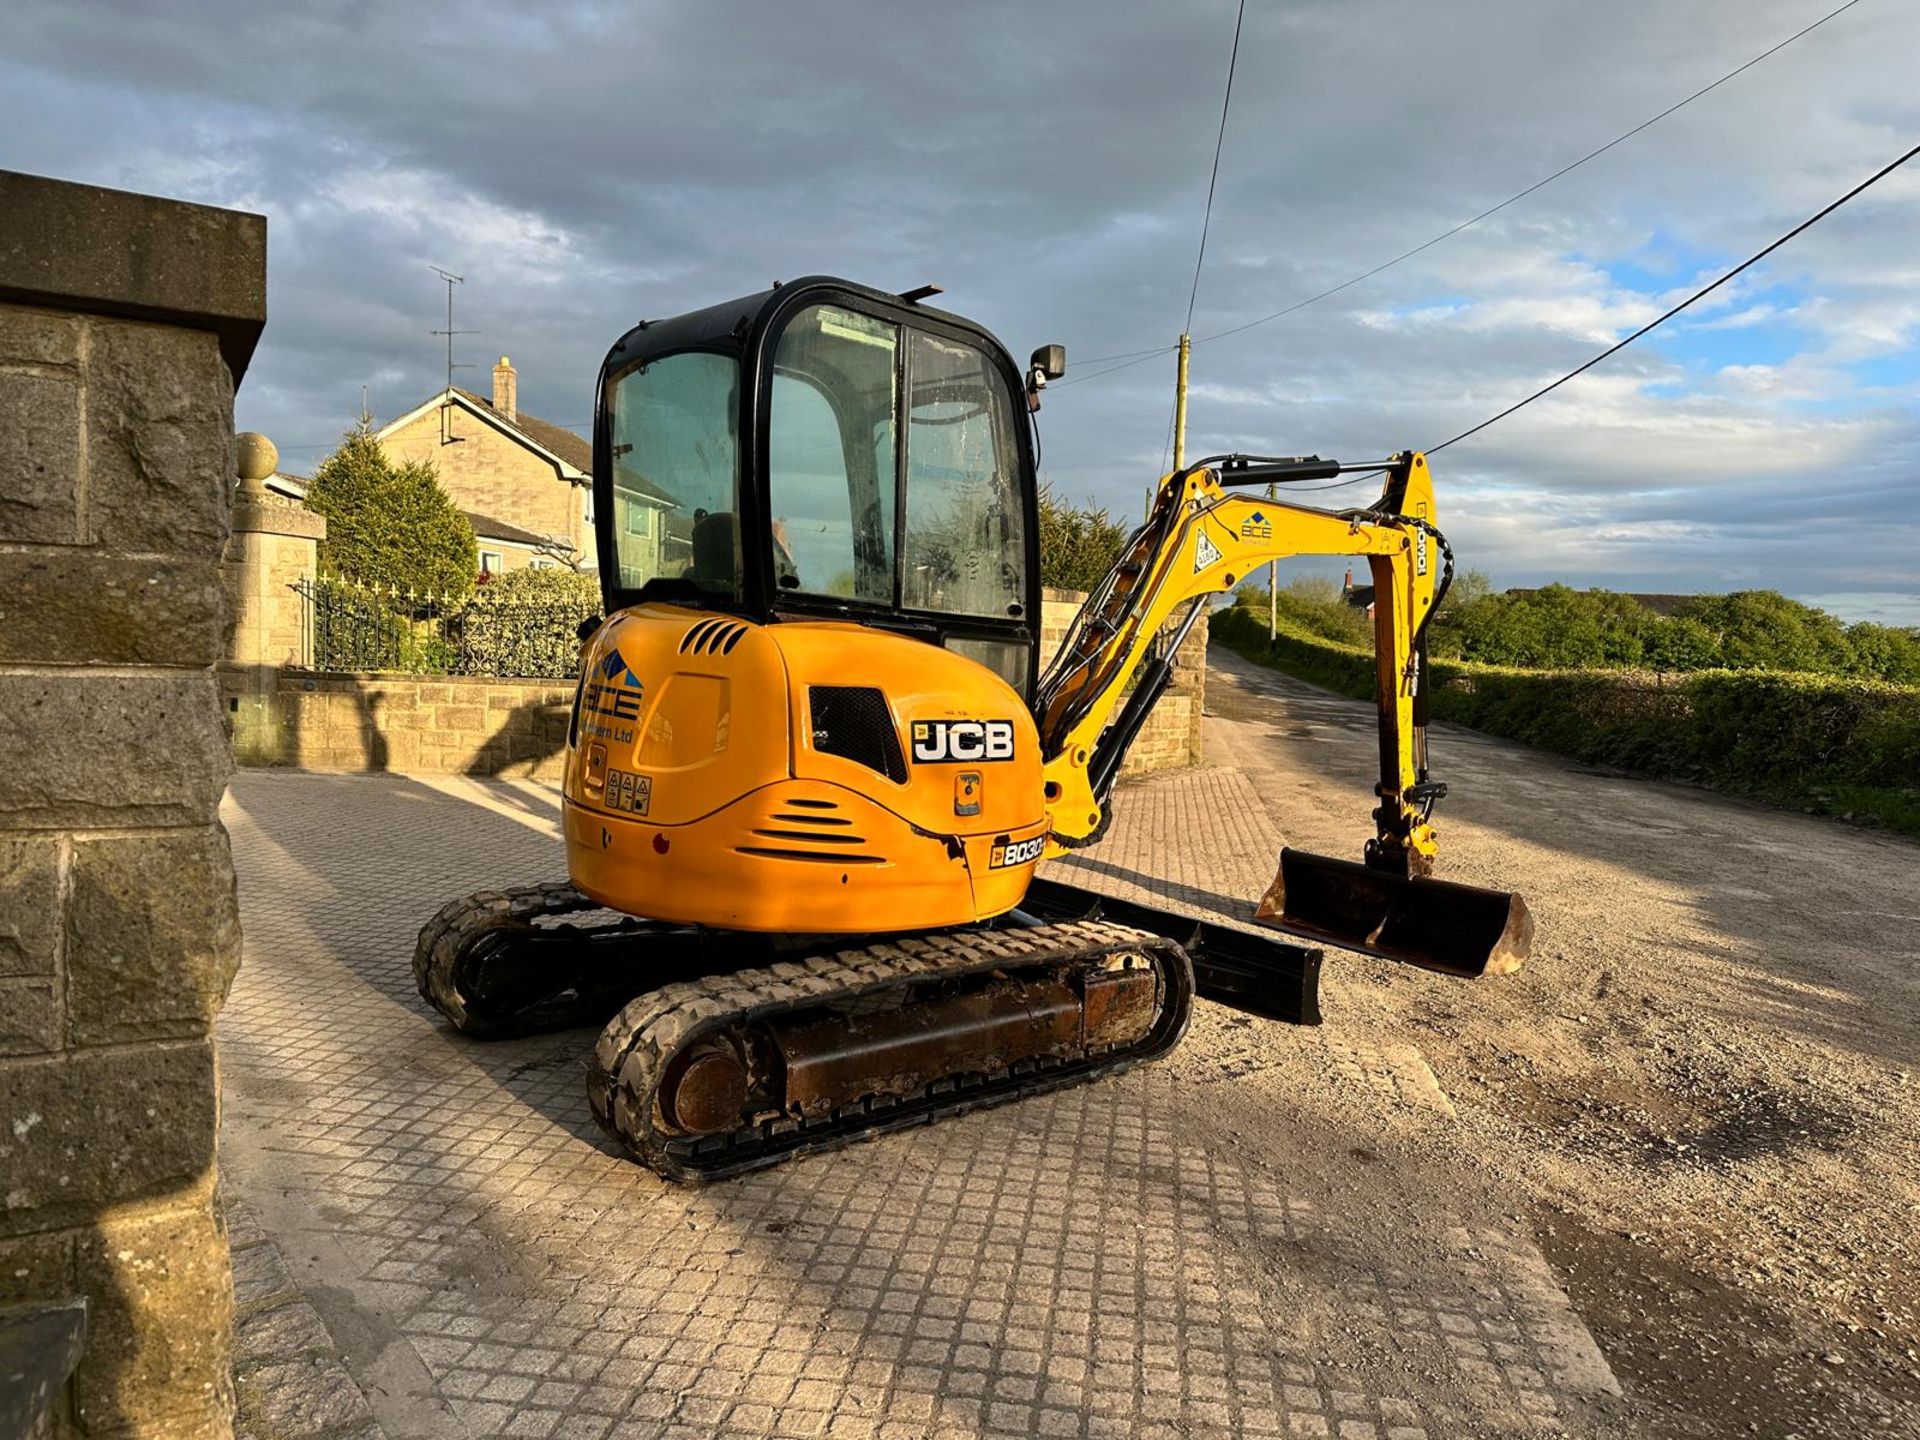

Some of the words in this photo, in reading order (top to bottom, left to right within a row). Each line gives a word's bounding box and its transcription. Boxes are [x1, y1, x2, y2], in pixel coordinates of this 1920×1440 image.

[1241, 525, 1272, 539] BCE
[614, 727, 633, 744] Ltd
[915, 723, 1013, 760] JCB
